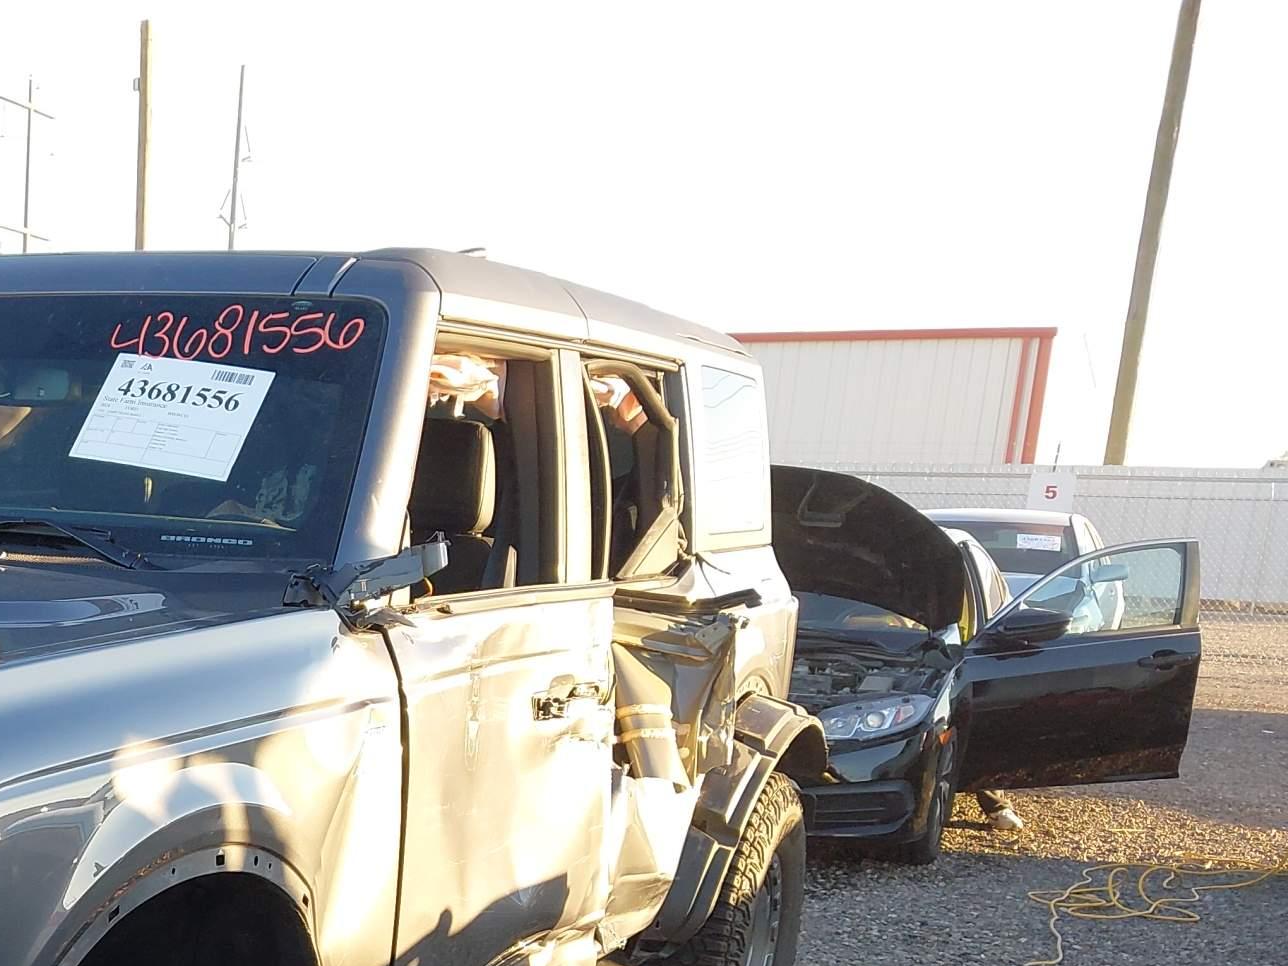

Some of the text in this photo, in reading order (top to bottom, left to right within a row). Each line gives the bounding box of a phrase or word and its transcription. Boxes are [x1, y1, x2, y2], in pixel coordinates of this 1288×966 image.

[110, 303, 366, 360] 43681556
[117, 377, 245, 412] 43681556
[1044, 485, 1059, 500] 5
[159, 534, 254, 547] BRONCO
